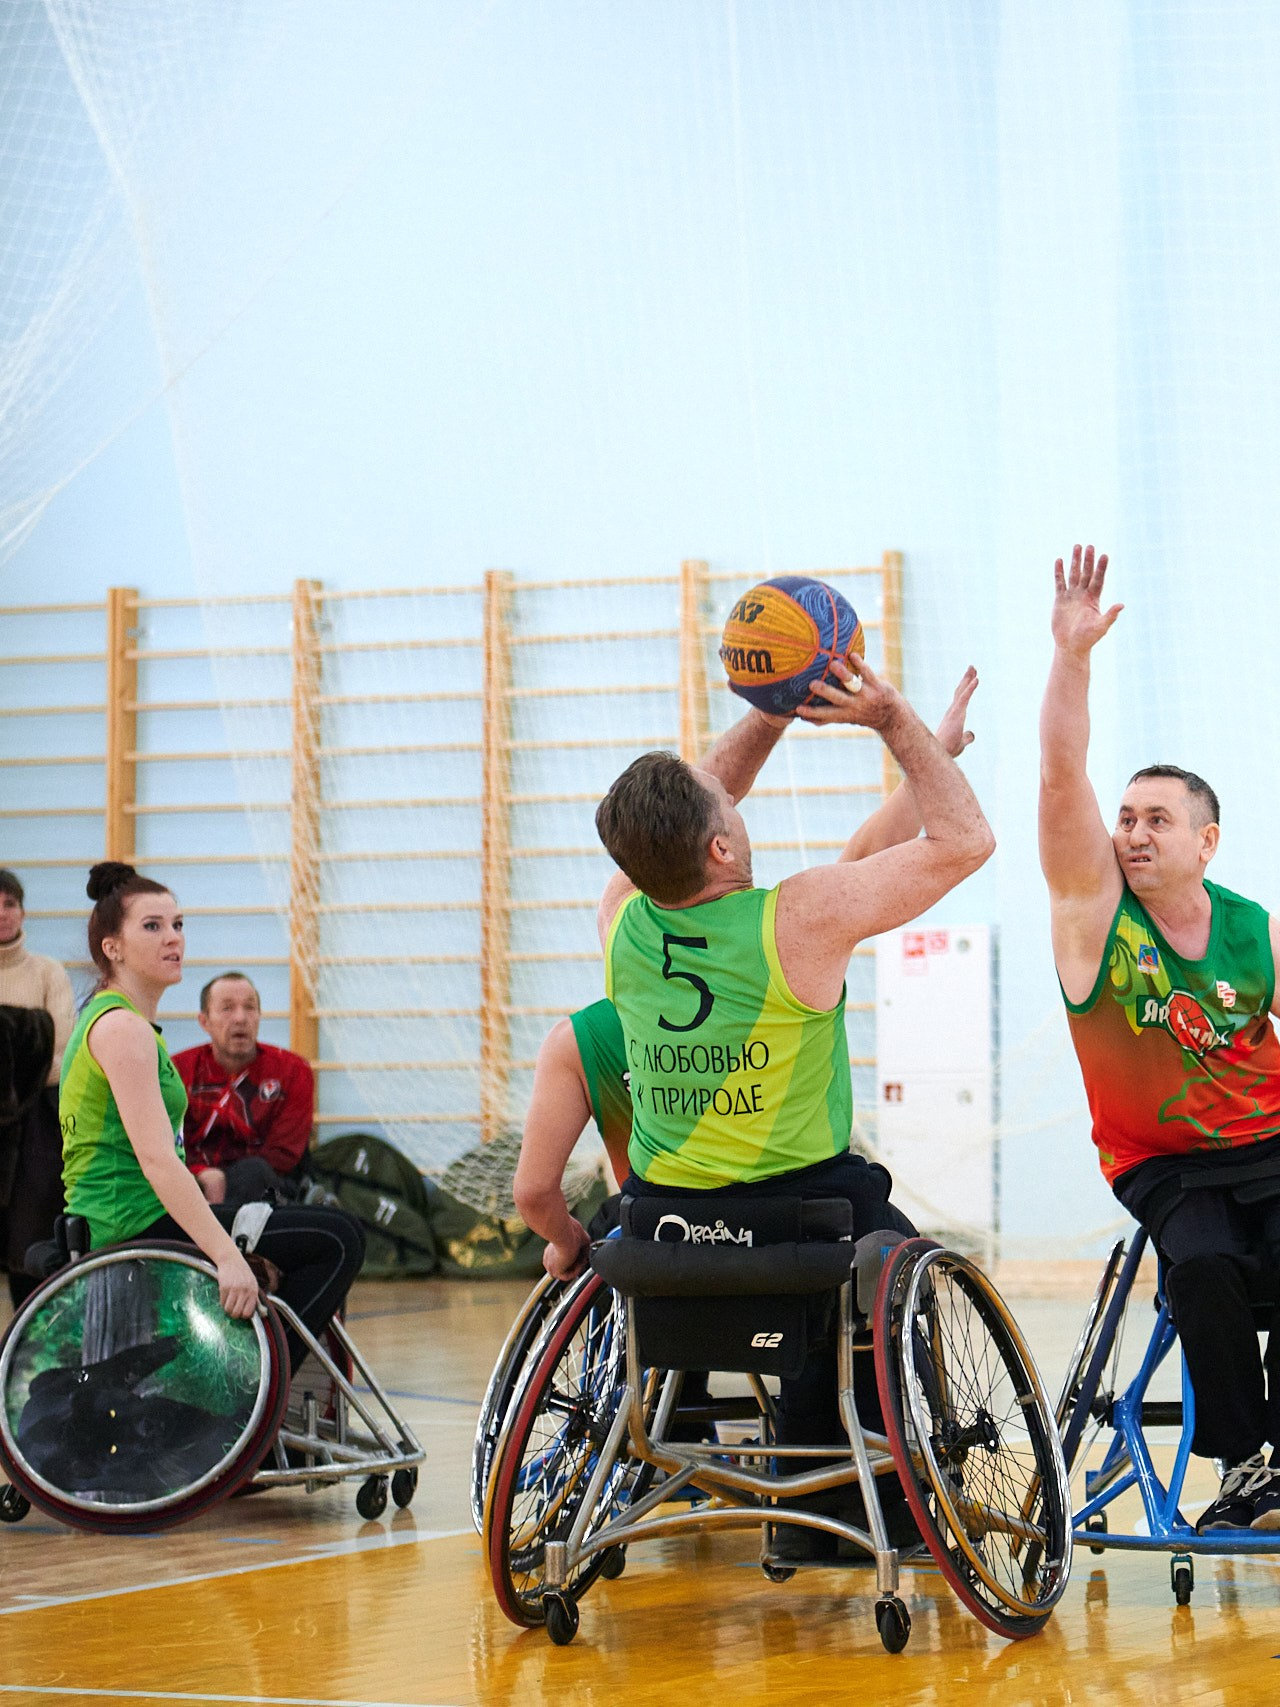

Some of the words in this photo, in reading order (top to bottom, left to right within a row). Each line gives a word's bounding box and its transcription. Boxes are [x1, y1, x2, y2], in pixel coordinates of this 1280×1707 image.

[722, 646, 775, 674] Wils
[657, 932, 715, 1032] 5
[643, 1041, 769, 1074] ЛЮБОВЬЮ
[651, 1084, 764, 1116] ПРИРОДЕ
[751, 1332, 784, 1348] G2
